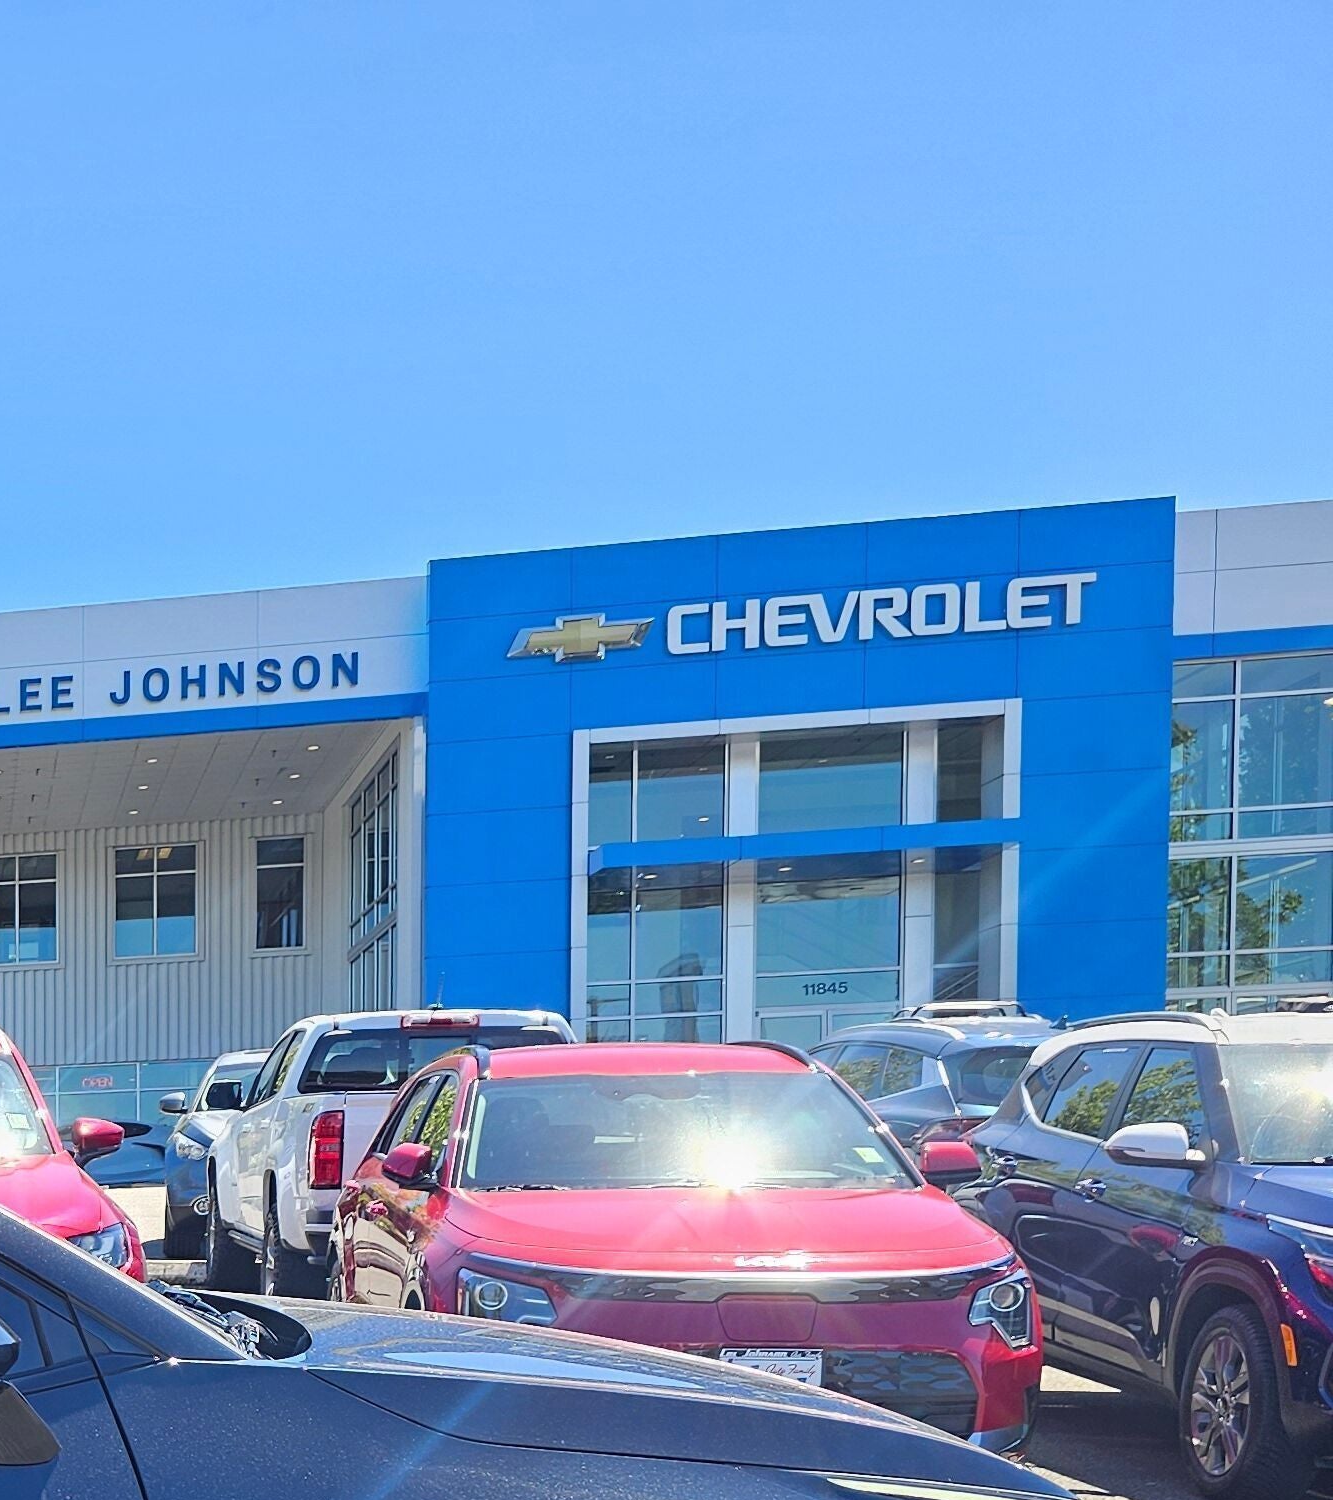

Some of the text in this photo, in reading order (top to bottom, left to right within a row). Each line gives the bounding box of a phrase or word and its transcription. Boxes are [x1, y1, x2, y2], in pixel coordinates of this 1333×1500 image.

[667, 572, 1097, 655] CHEVROLET
[109, 651, 359, 705] JOHNSON
[802, 981, 848, 996] 11845
[82, 1076, 113, 1088] OPEN
